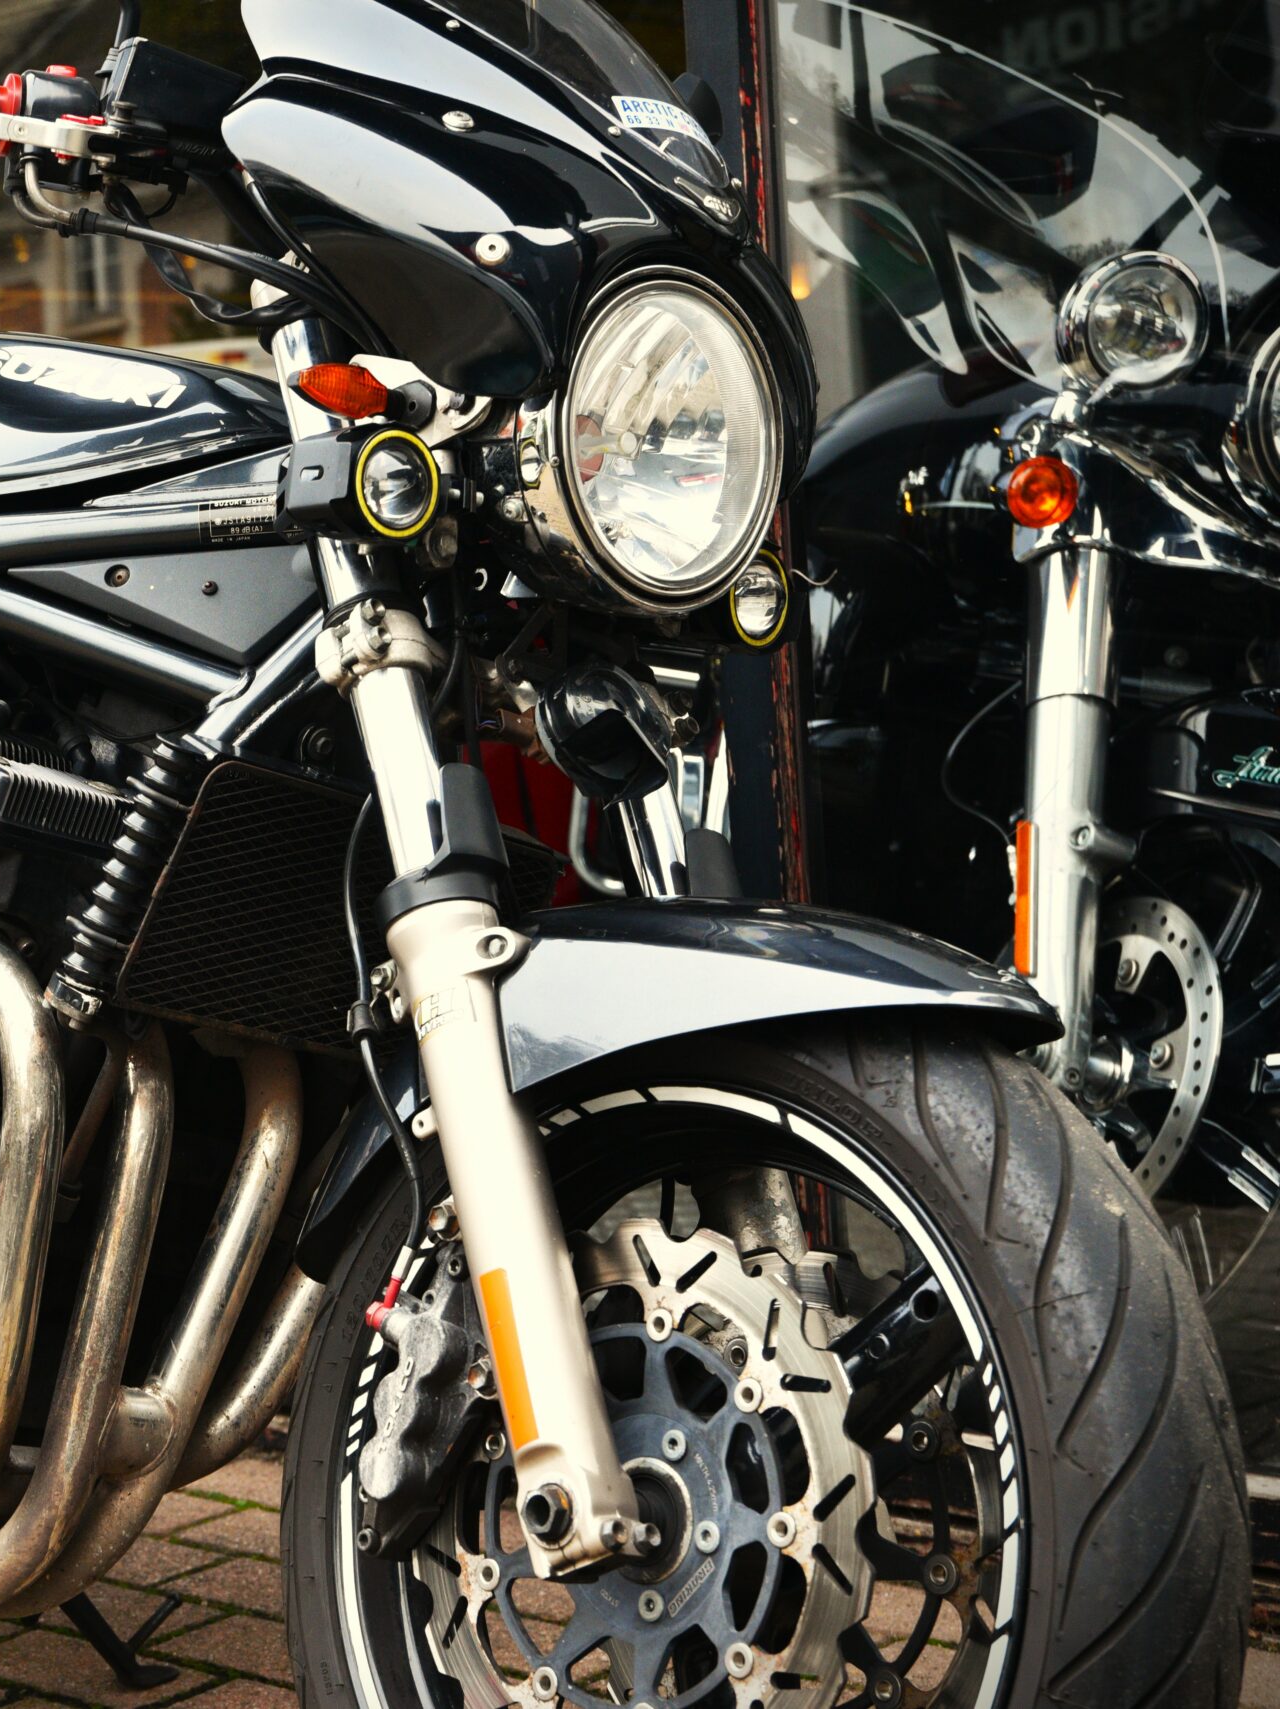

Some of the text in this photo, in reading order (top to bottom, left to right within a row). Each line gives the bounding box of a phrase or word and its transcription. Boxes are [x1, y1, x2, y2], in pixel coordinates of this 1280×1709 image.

[621, 99, 678, 119] ARCTIC
[703, 195, 733, 217] GIVI
[668, 1558, 715, 1617] BRAKING
